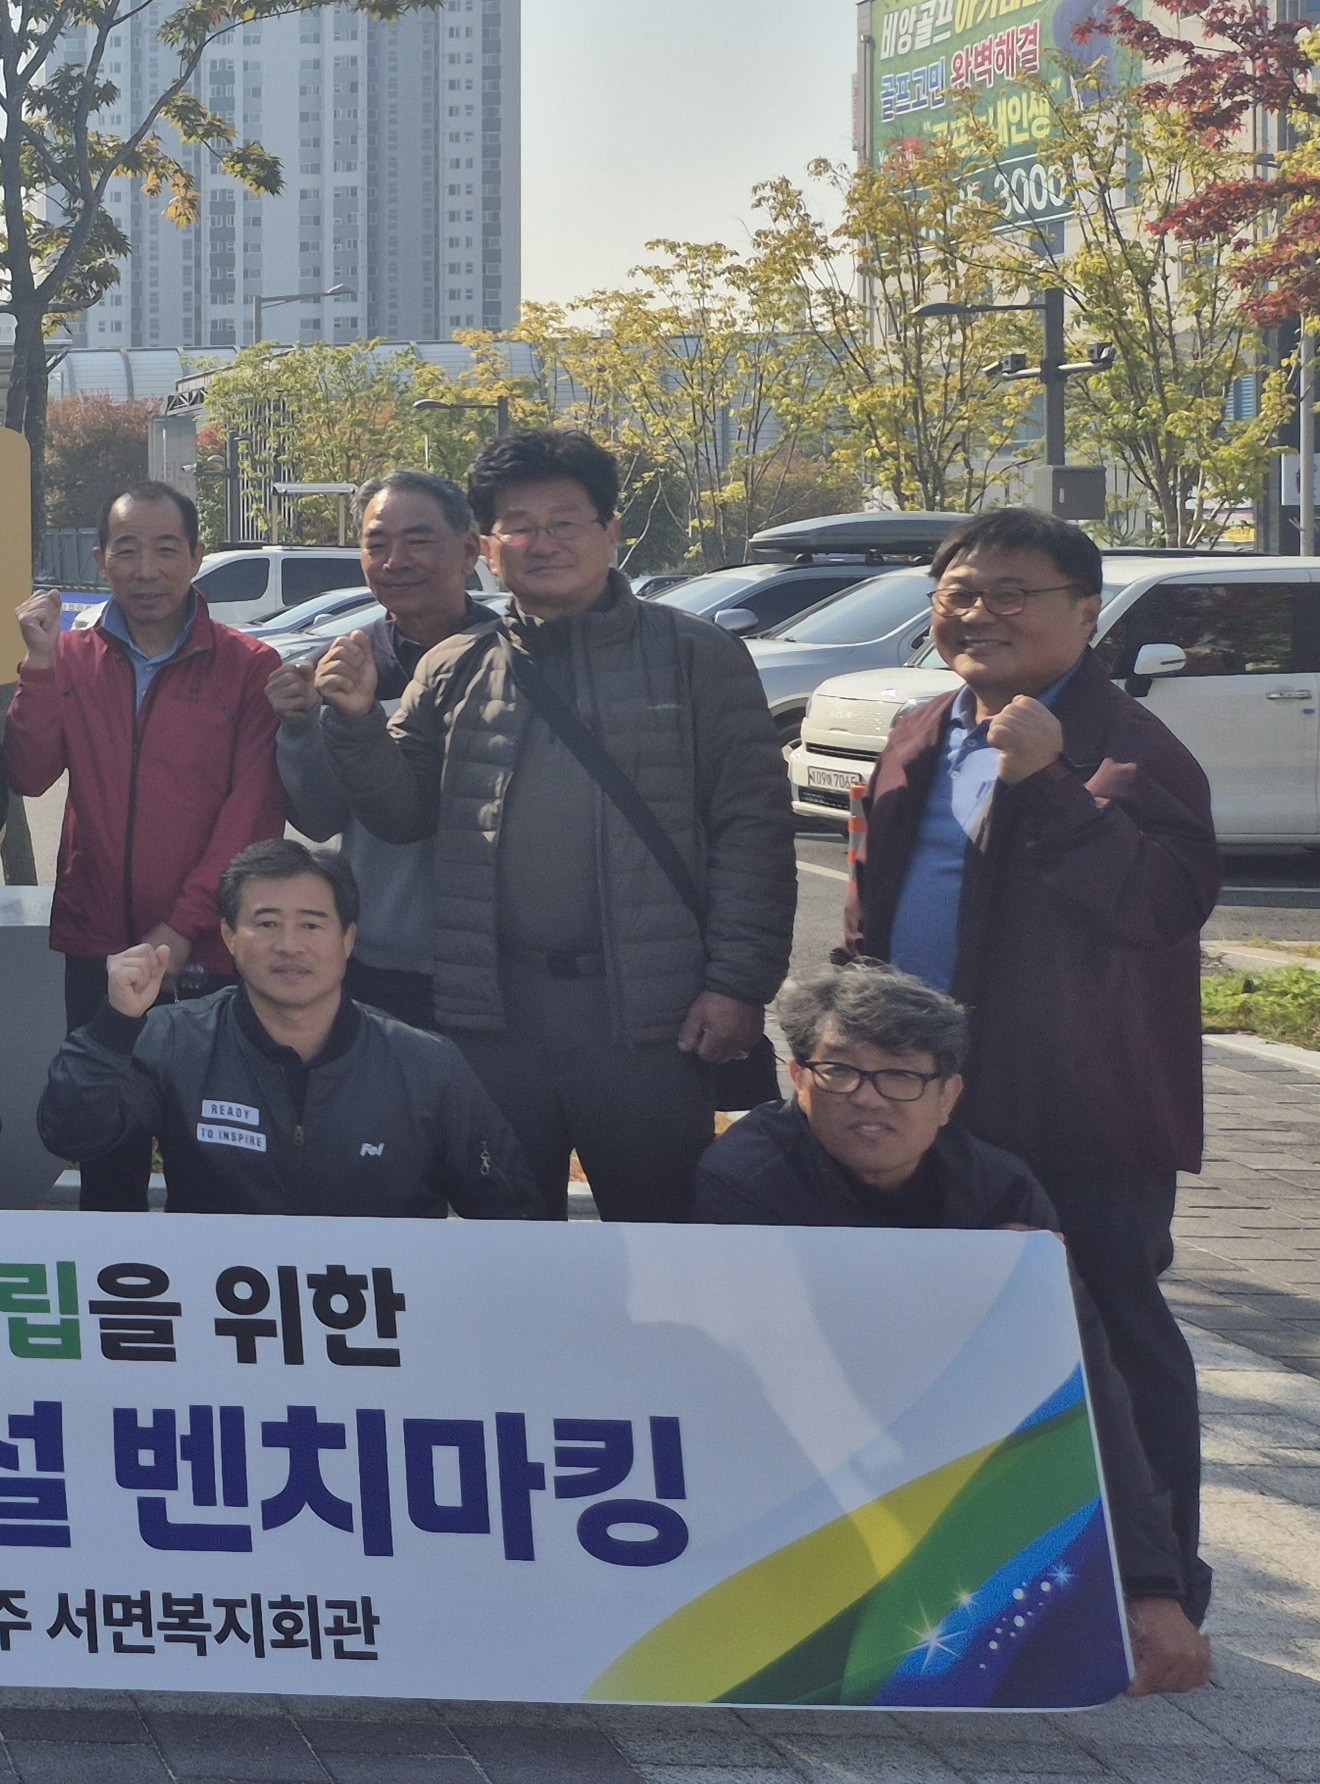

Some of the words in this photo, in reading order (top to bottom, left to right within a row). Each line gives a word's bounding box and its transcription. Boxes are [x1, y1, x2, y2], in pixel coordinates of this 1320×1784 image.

[881, 56, 946, 123] 골프고민
[201, 1127, 214, 1139] TO
[218, 1130, 262, 1147] INSPIRE
[211, 1104, 250, 1120] READY
[214, 1265, 406, 1367] 위한
[113, 1405, 689, 1567] 벤치마킹
[46, 1589, 380, 1661] 서면복지회관
